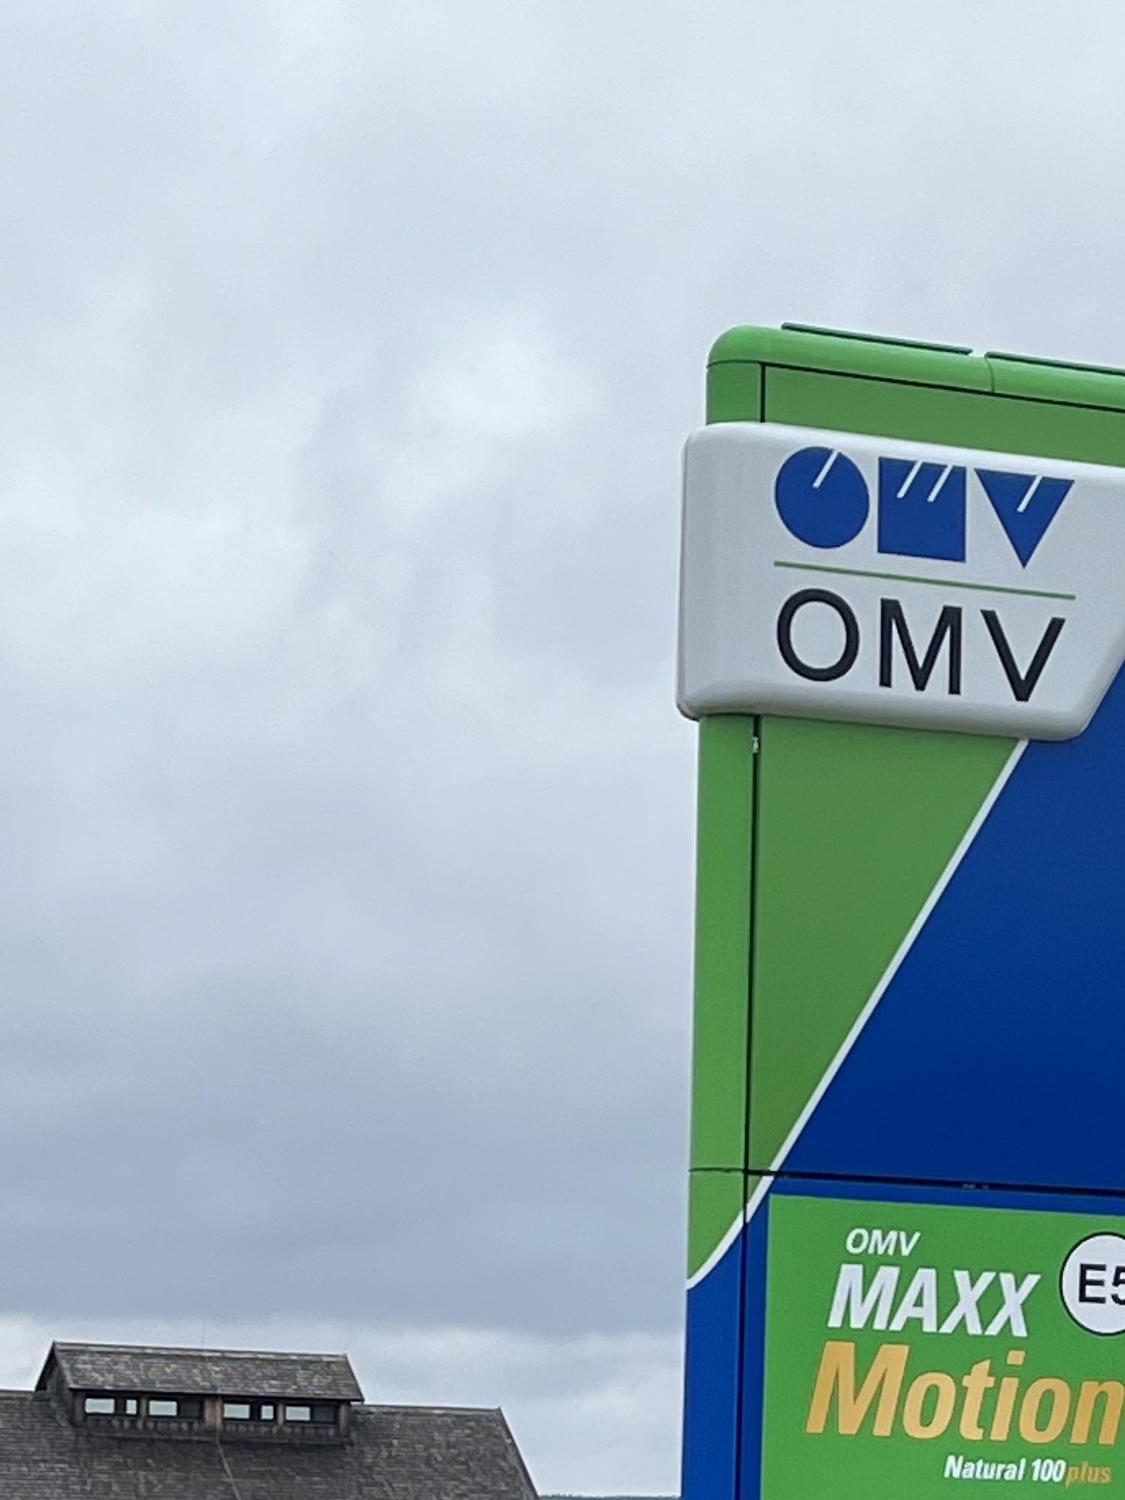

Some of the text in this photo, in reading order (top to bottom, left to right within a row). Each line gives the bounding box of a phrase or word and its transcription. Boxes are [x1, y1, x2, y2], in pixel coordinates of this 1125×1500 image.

[776, 588, 1066, 702] OMV
[845, 1228, 920, 1257] OMV
[827, 1264, 1041, 1337] MAXX
[804, 1340, 1125, 1446] Motion
[944, 1454, 1026, 1482] Natural
